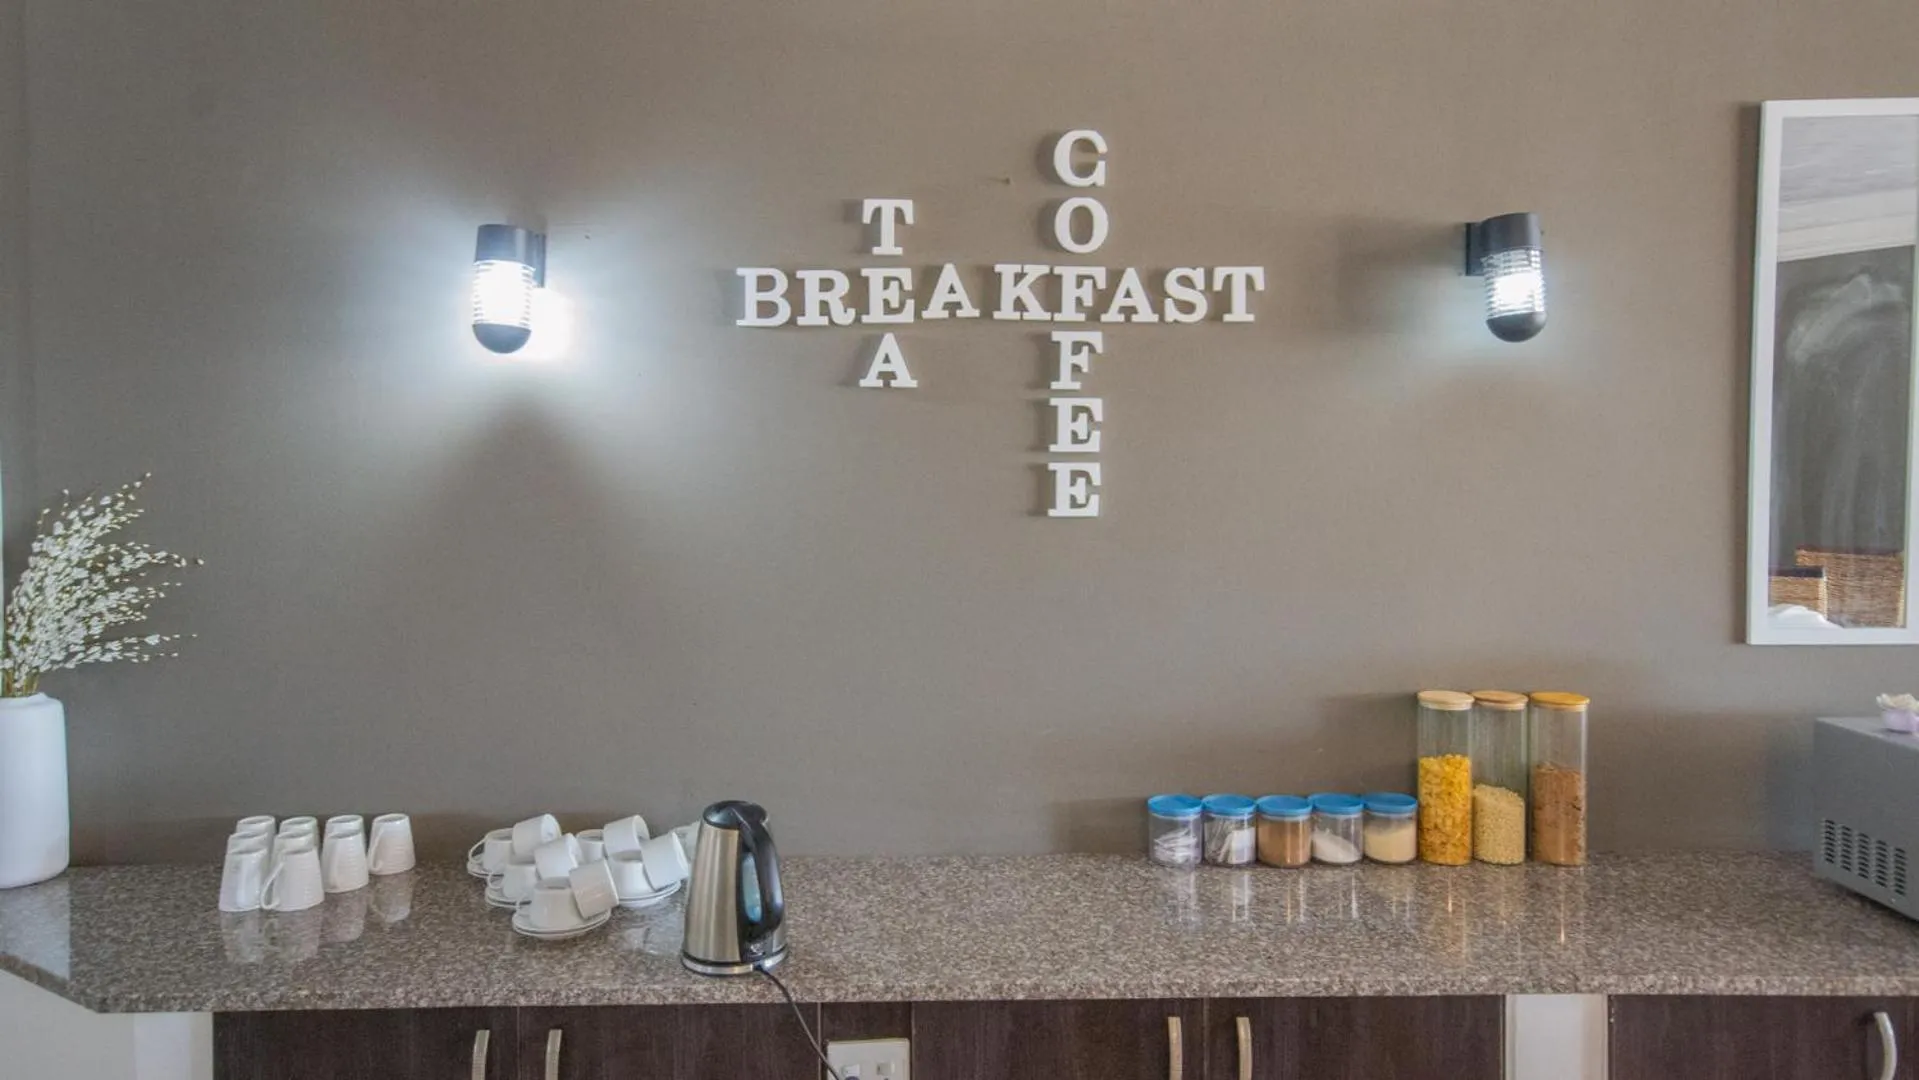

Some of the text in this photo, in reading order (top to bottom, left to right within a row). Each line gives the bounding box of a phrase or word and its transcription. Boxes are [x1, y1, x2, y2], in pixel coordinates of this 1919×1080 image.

[736, 263, 1265, 326] BREAKFAST
[859, 199, 918, 388] TEA
[1048, 130, 1109, 517] COFFEE
